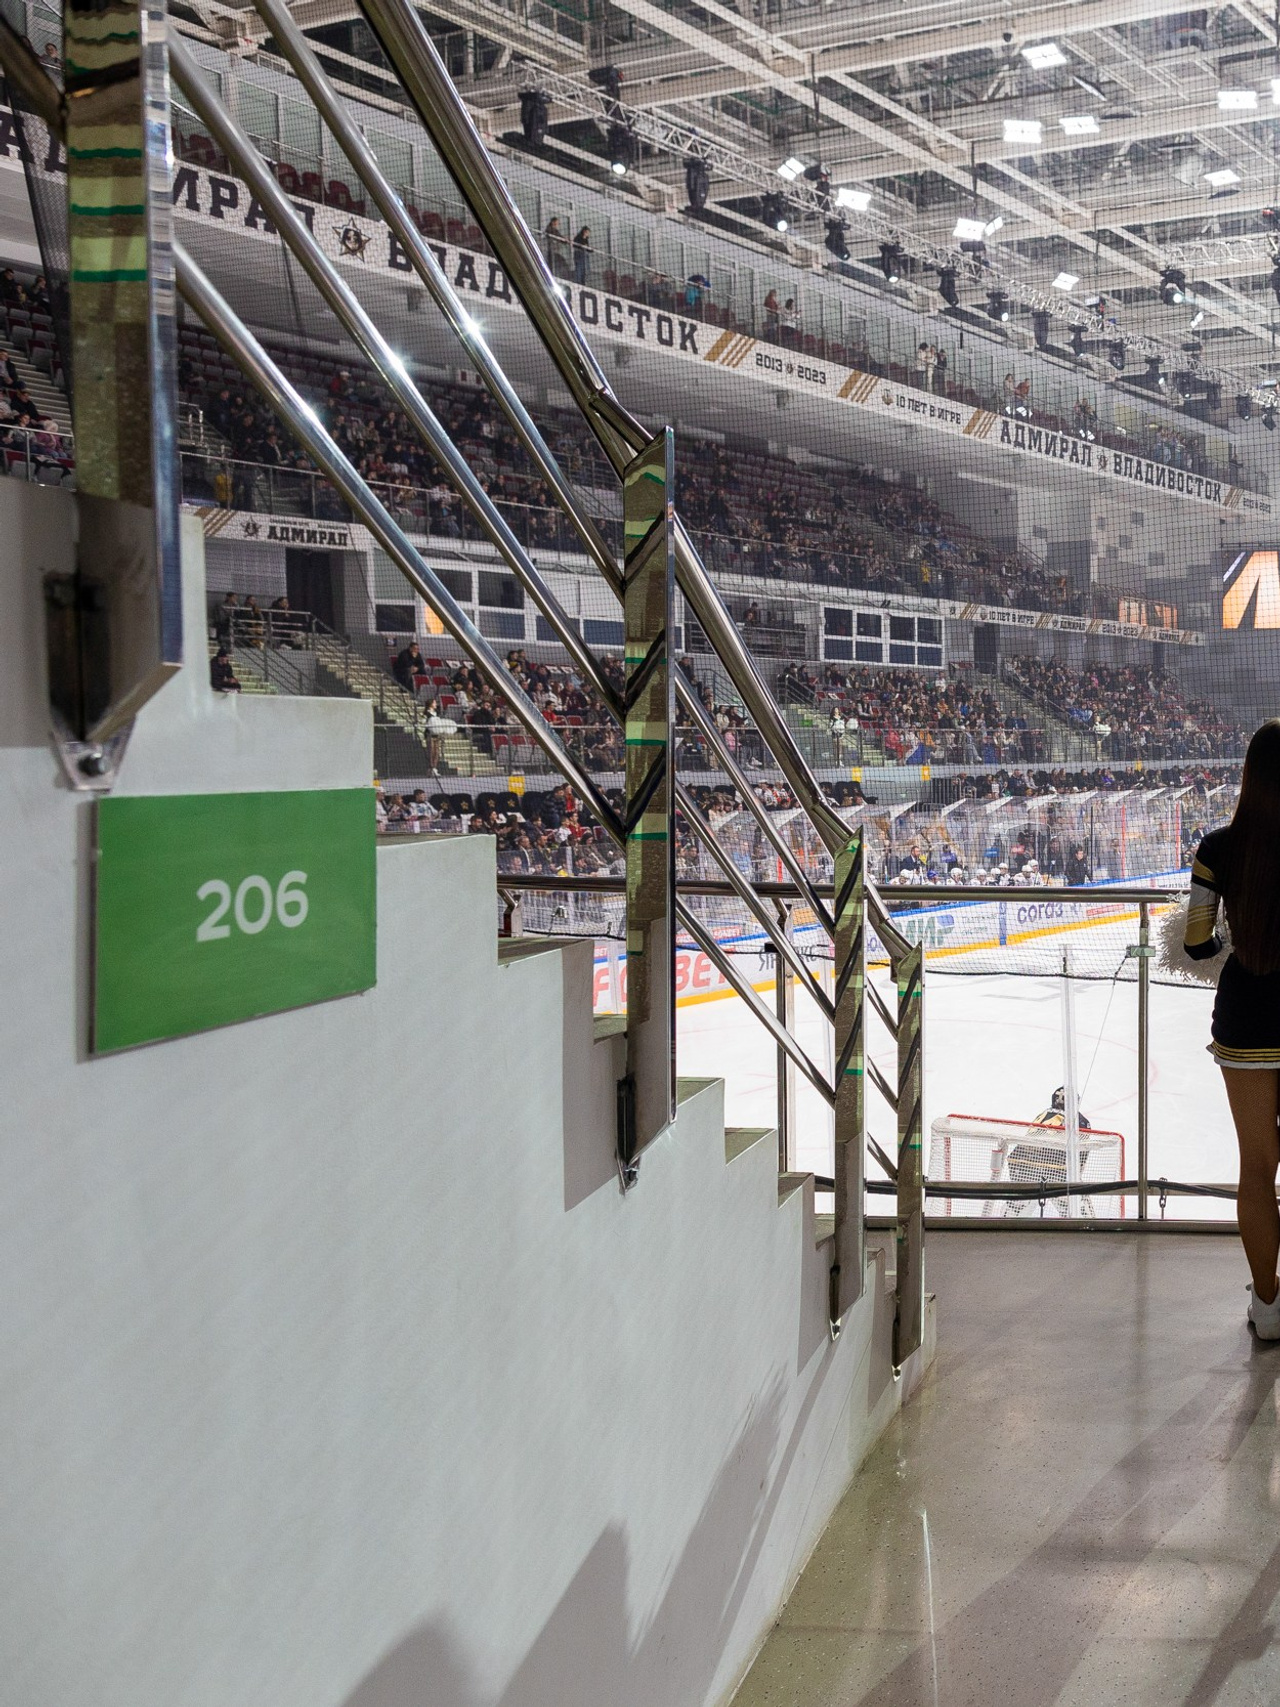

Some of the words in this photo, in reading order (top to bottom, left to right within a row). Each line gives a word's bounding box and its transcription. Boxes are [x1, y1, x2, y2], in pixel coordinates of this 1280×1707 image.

[755, 352, 783, 373] 2013
[797, 365, 827, 385] 2023
[907, 397, 928, 415] ЛЕТ
[937, 406, 961, 425] ИГРЕ
[1000, 420, 1092, 468] АДМИРАЛ
[1113, 452, 1222, 502] ВЛАДИВОСТОК
[267, 525, 348, 546] АДМИРАЛ
[196, 870, 309, 942] 206
